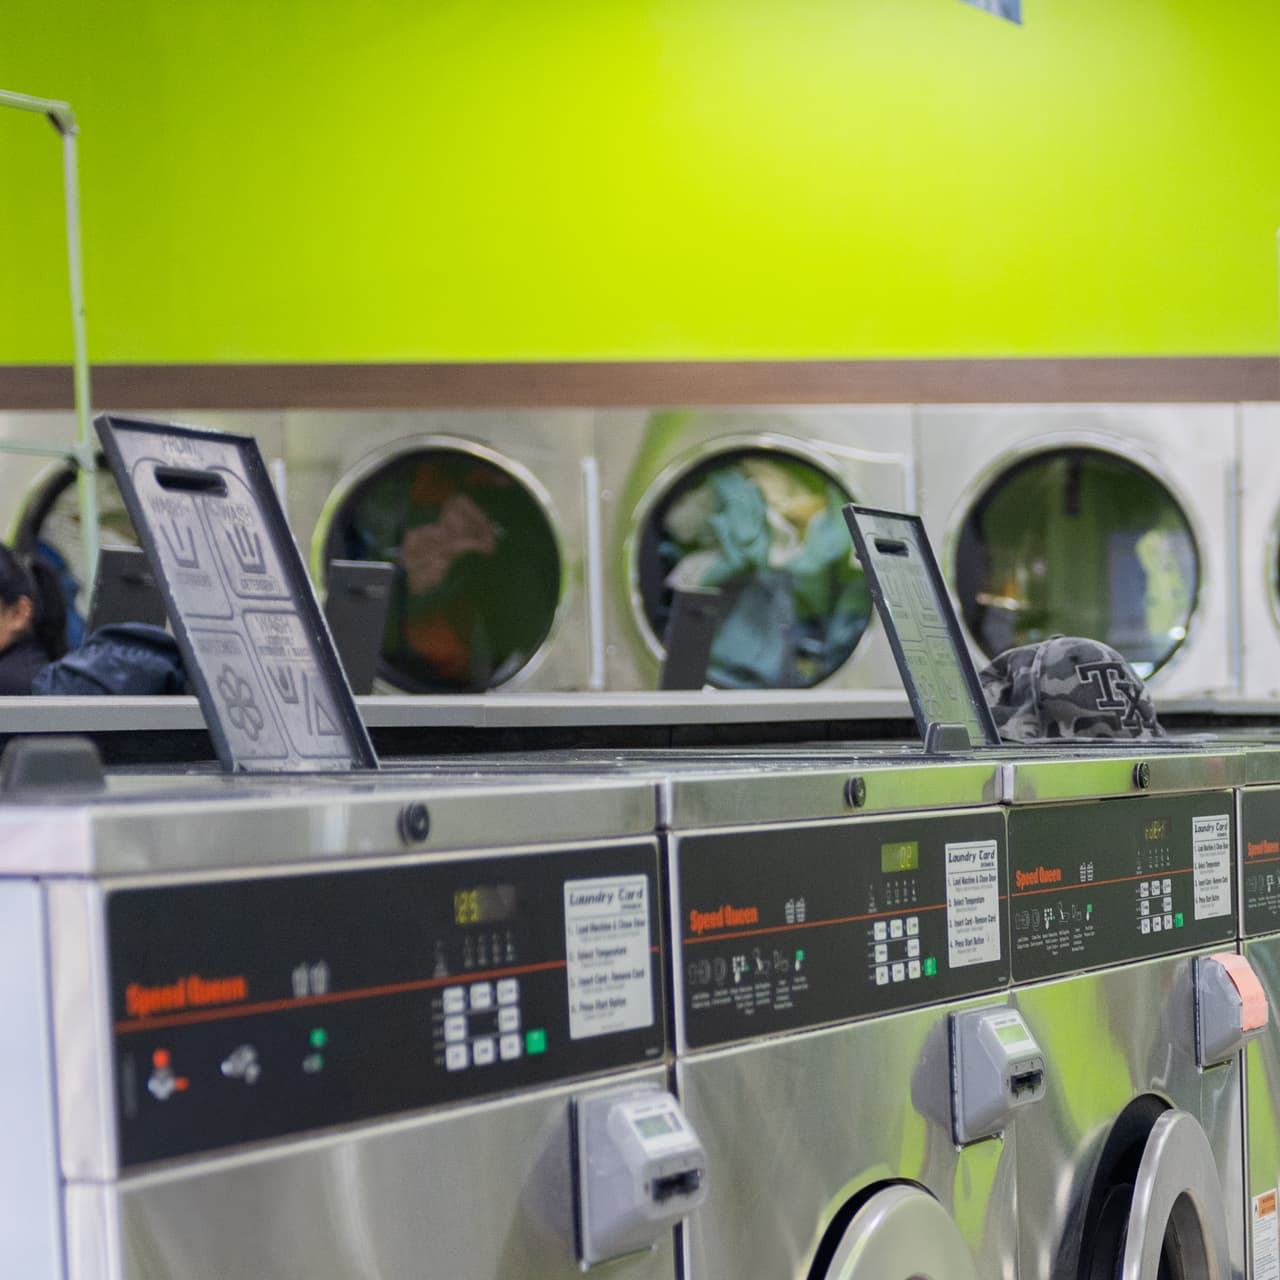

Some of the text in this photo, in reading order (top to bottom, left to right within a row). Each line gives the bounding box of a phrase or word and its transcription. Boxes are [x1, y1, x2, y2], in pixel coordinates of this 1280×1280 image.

[1195, 823, 1227, 833] Laundry Card
[948, 850, 995, 863] Laundry Card
[1016, 866, 1062, 890] Speed Queen
[569, 888, 643, 906] Laundry Card
[690, 904, 759, 936] Speed Queen
